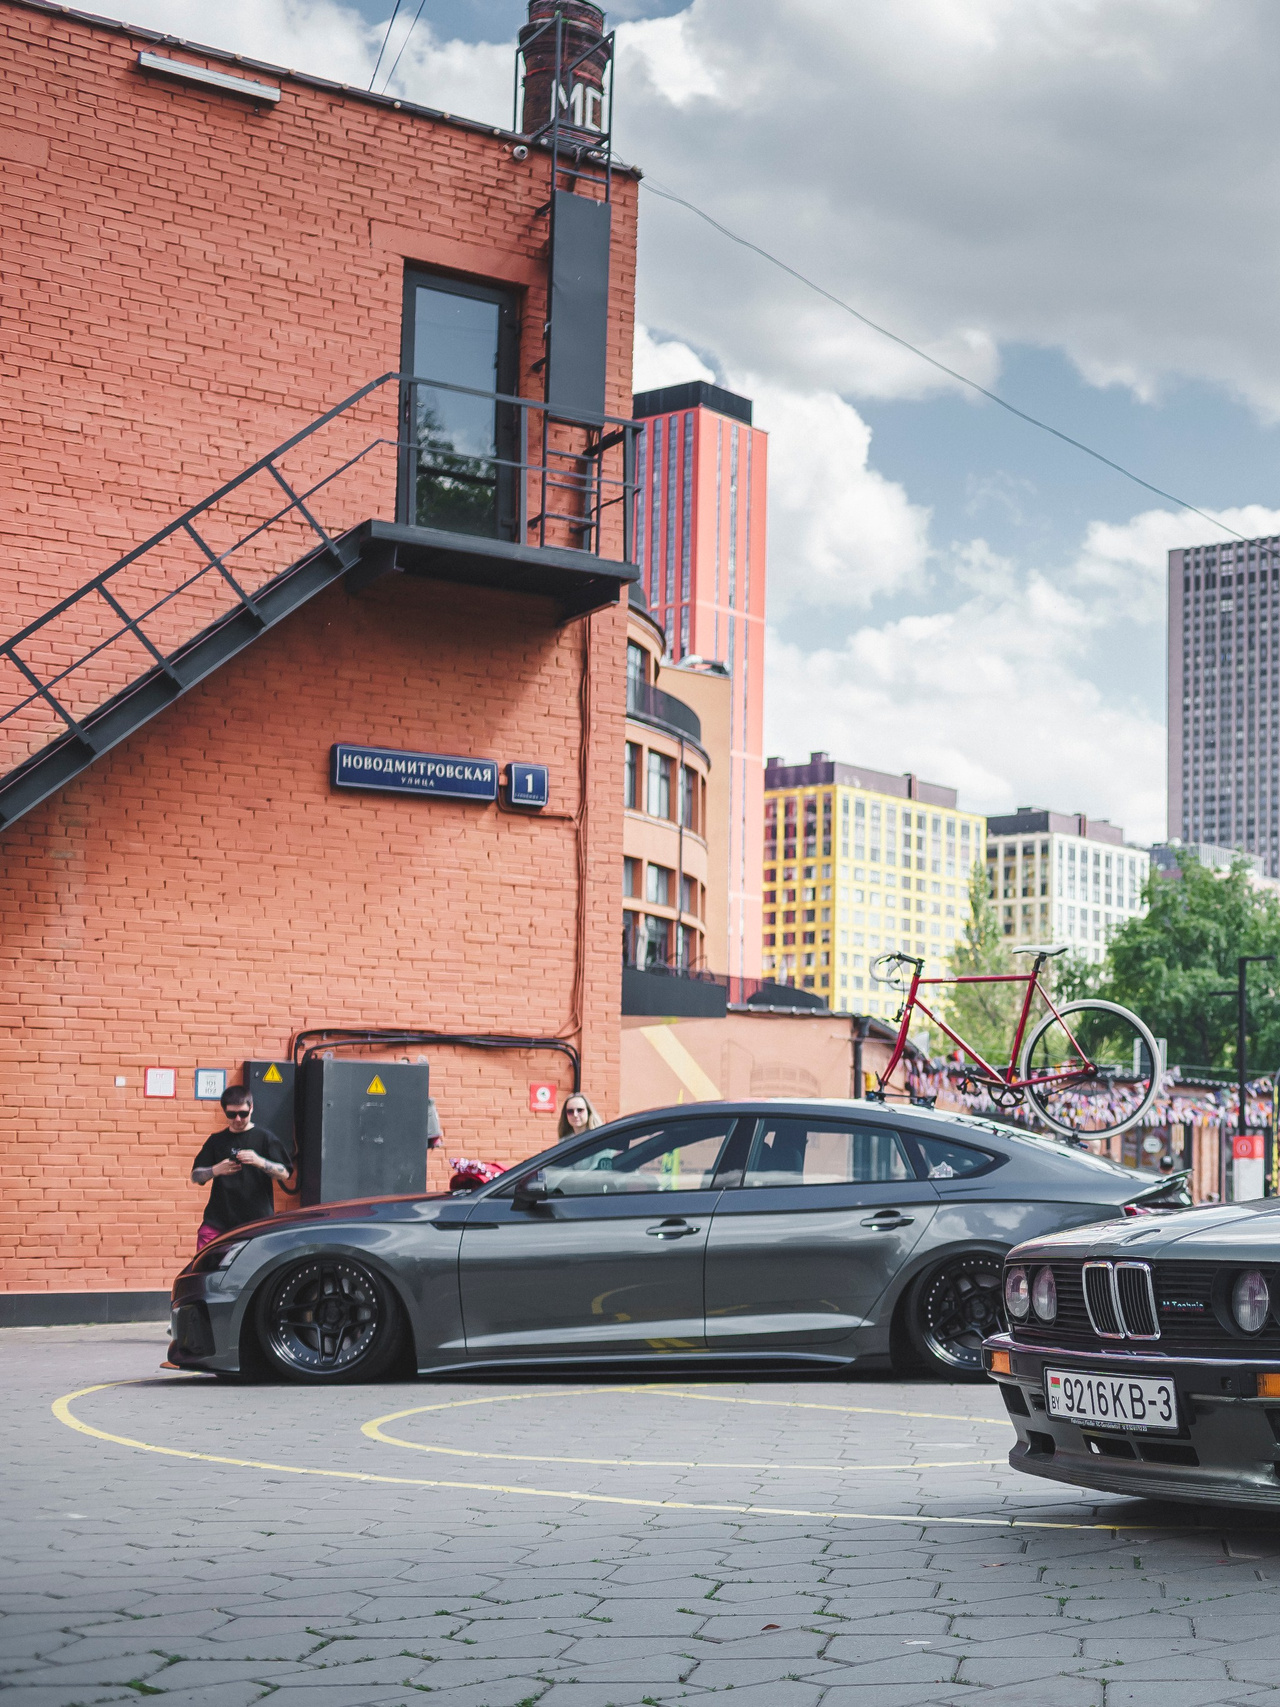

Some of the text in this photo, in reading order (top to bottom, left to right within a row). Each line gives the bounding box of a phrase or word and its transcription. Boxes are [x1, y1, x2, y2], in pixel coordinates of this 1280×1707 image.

[342, 754, 492, 783] НОВОДМИТРОВСКАЯ
[401, 776, 435, 787] УЛИЦА
[525, 773, 533, 793] 1
[1051, 1396, 1060, 1410] BY
[1063, 1378, 1172, 1421] 9216KB-3
